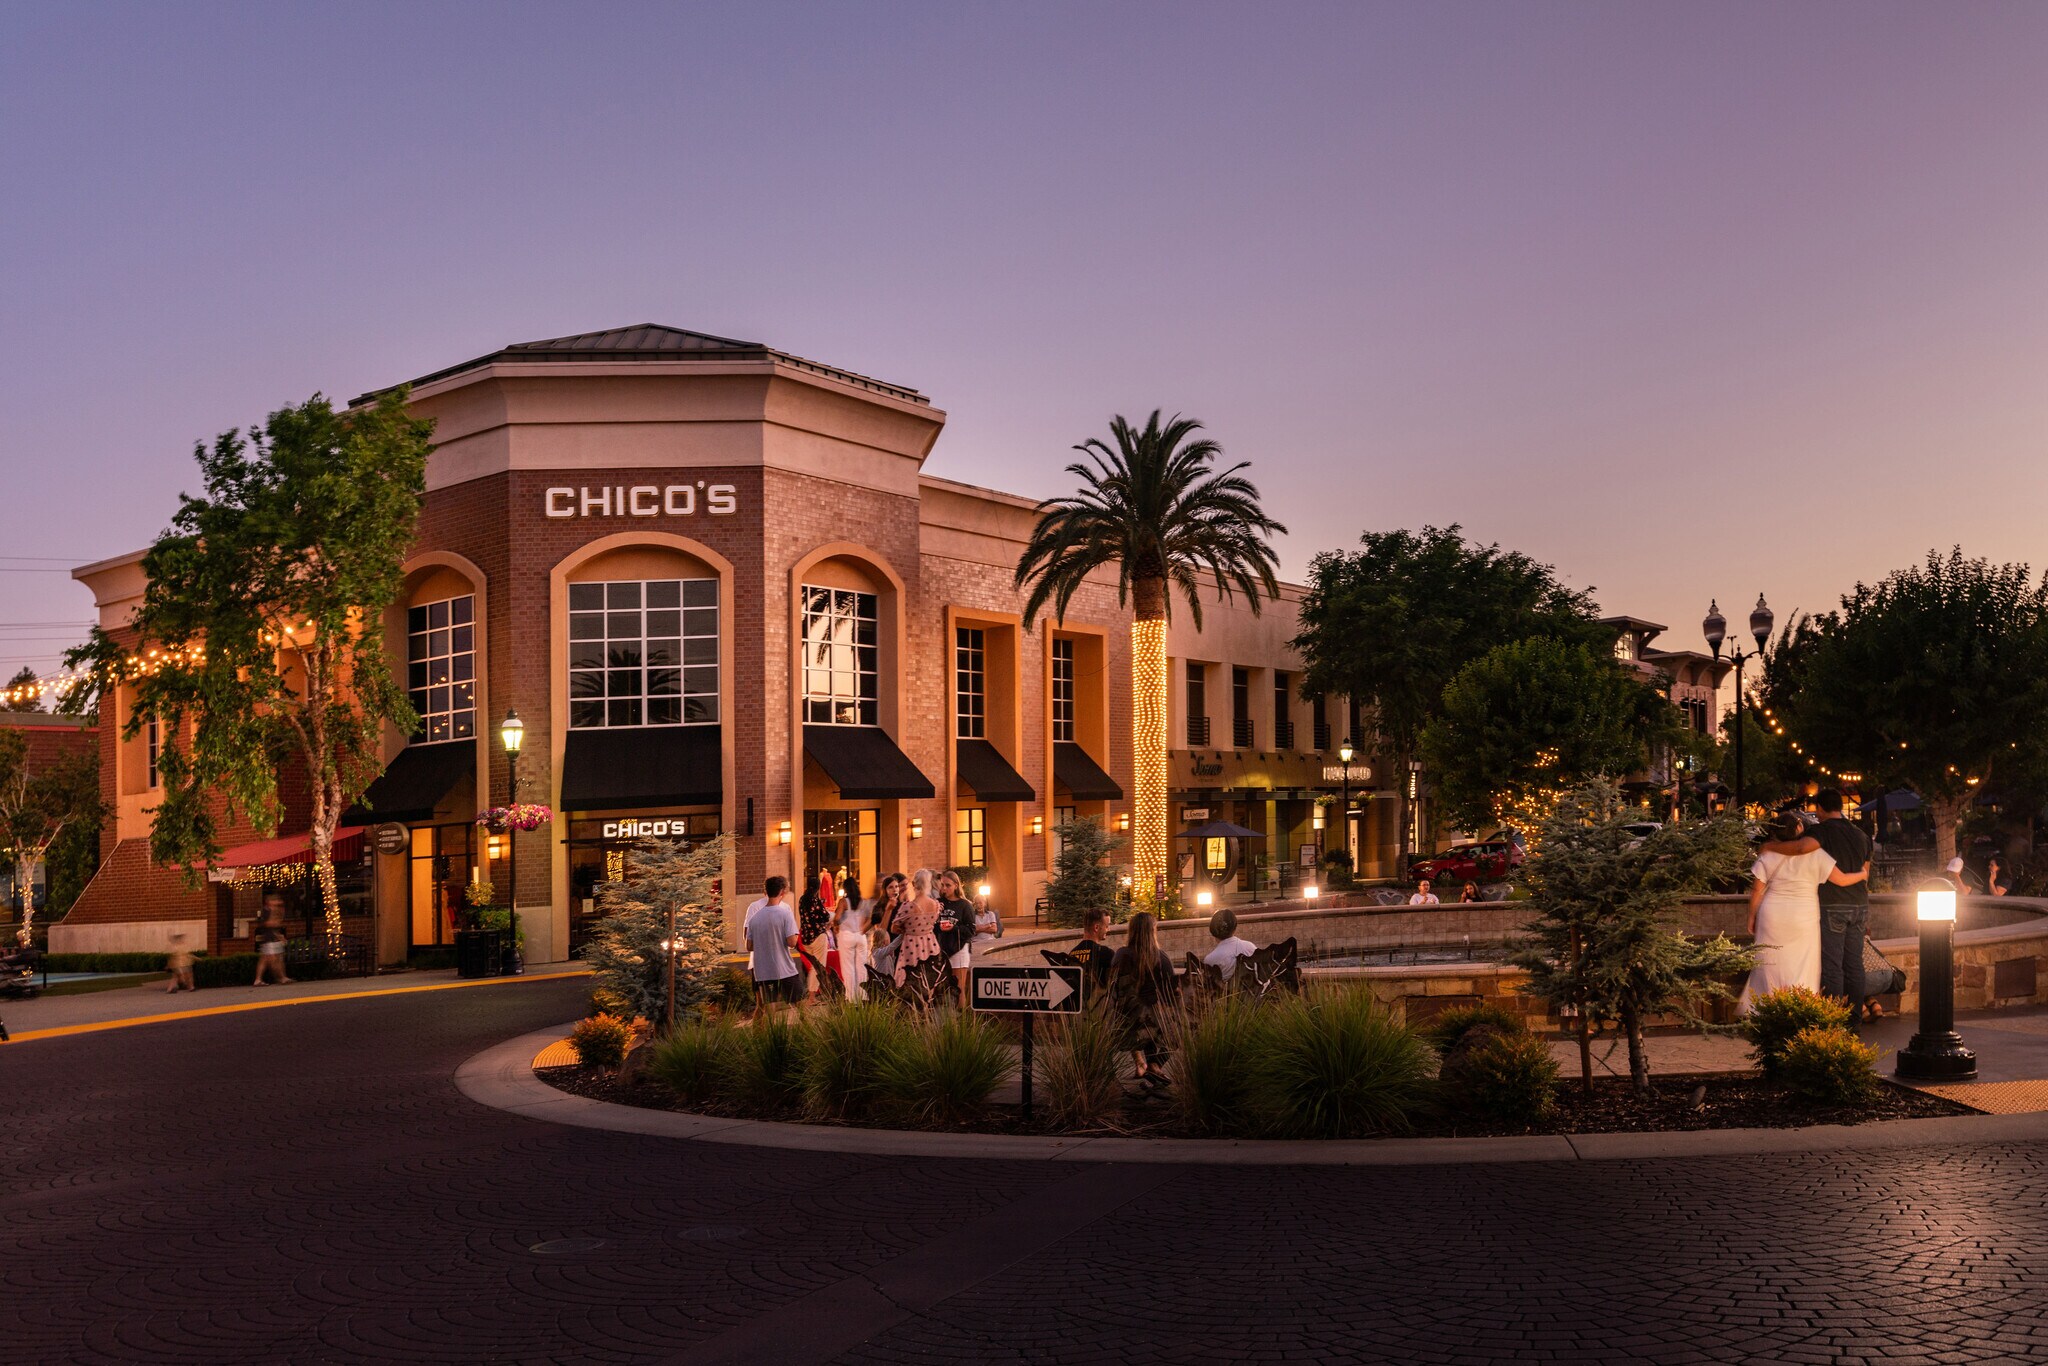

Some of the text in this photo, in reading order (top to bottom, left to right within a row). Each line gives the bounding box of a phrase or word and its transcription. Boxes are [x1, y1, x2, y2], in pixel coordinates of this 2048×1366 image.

[545, 480, 736, 517] CHICO'S
[603, 819, 685, 838] CHICO'S
[984, 980, 1048, 997] ONE WAY
